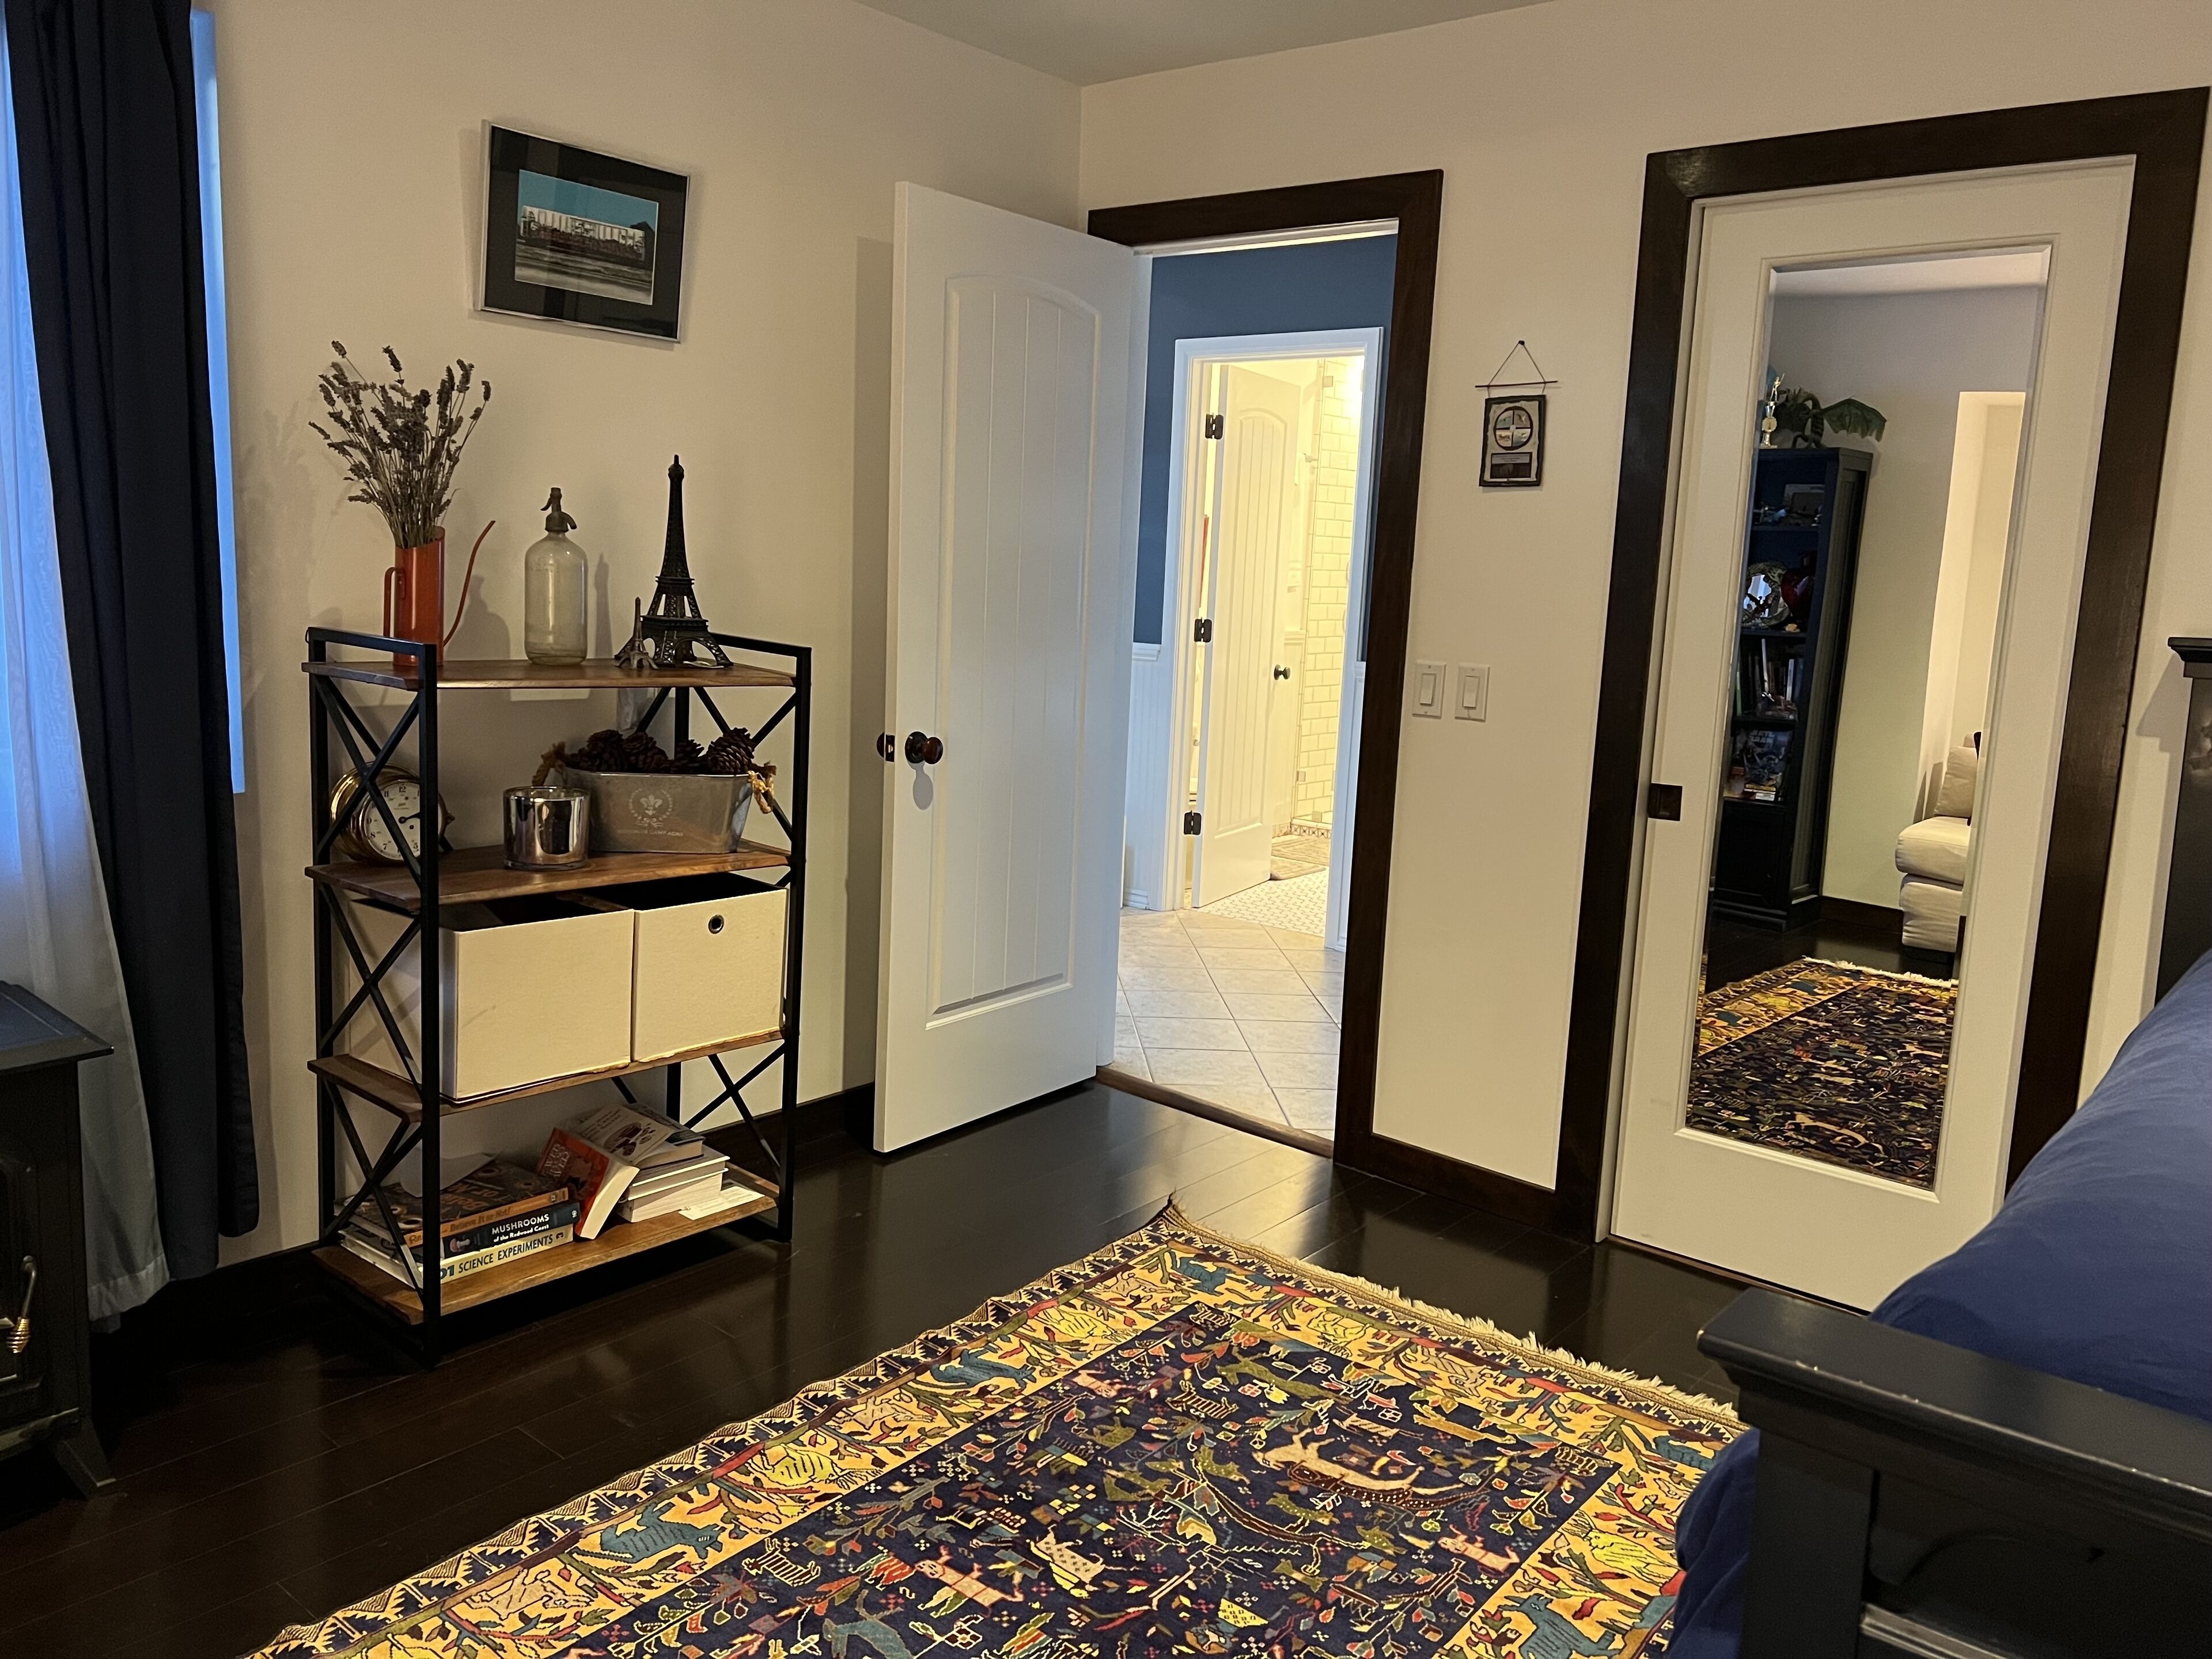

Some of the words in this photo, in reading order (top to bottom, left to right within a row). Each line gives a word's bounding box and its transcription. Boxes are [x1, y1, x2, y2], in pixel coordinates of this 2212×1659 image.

[492, 1214, 550, 1235] MUSHROOMS
[509, 1227, 533, 1238] Redwood
[458, 1253, 494, 1273] SCIENCE
[498, 1234, 553, 1261] EXPERIMENTS
